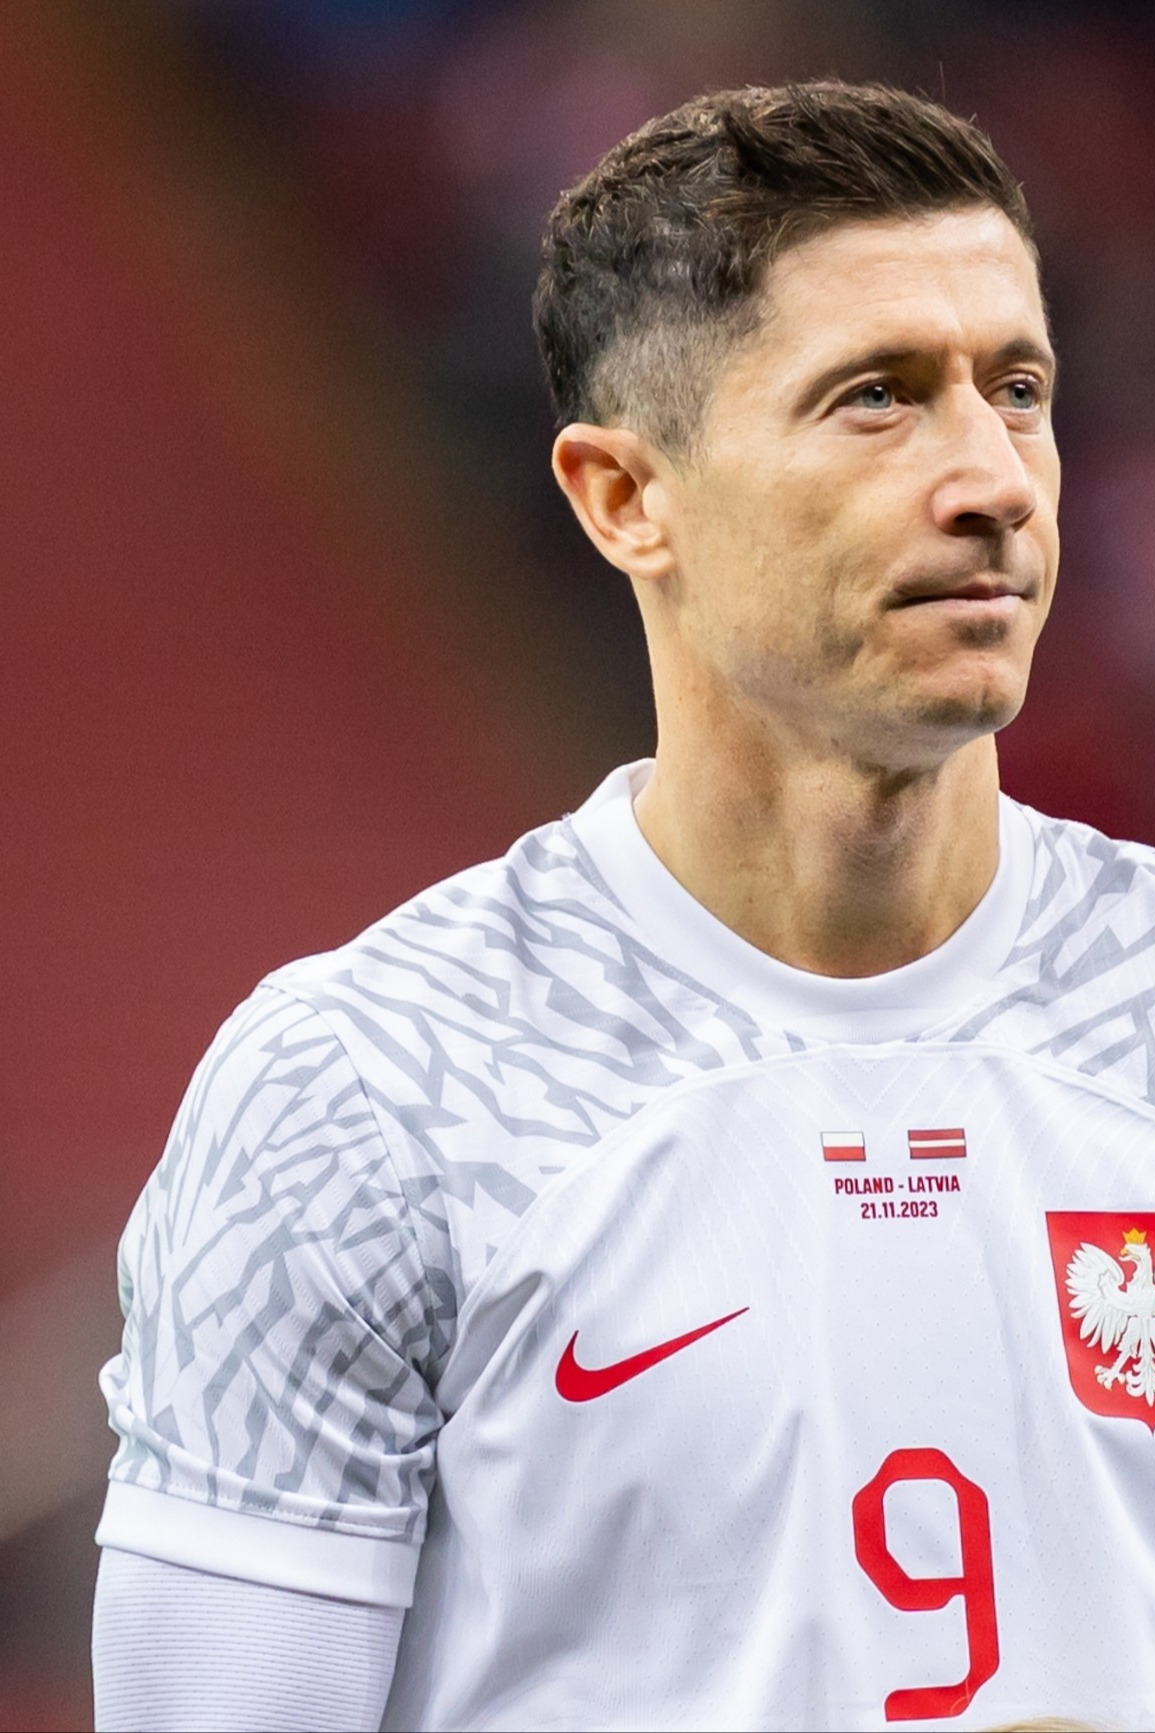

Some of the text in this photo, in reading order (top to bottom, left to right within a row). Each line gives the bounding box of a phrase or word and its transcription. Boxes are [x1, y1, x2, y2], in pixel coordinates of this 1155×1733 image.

[834, 1177, 894, 1195] POLAND
[908, 1175, 961, 1193] LATVIA
[860, 1201, 938, 1219] 21.11.2023
[852, 1448, 1000, 1722] 9
